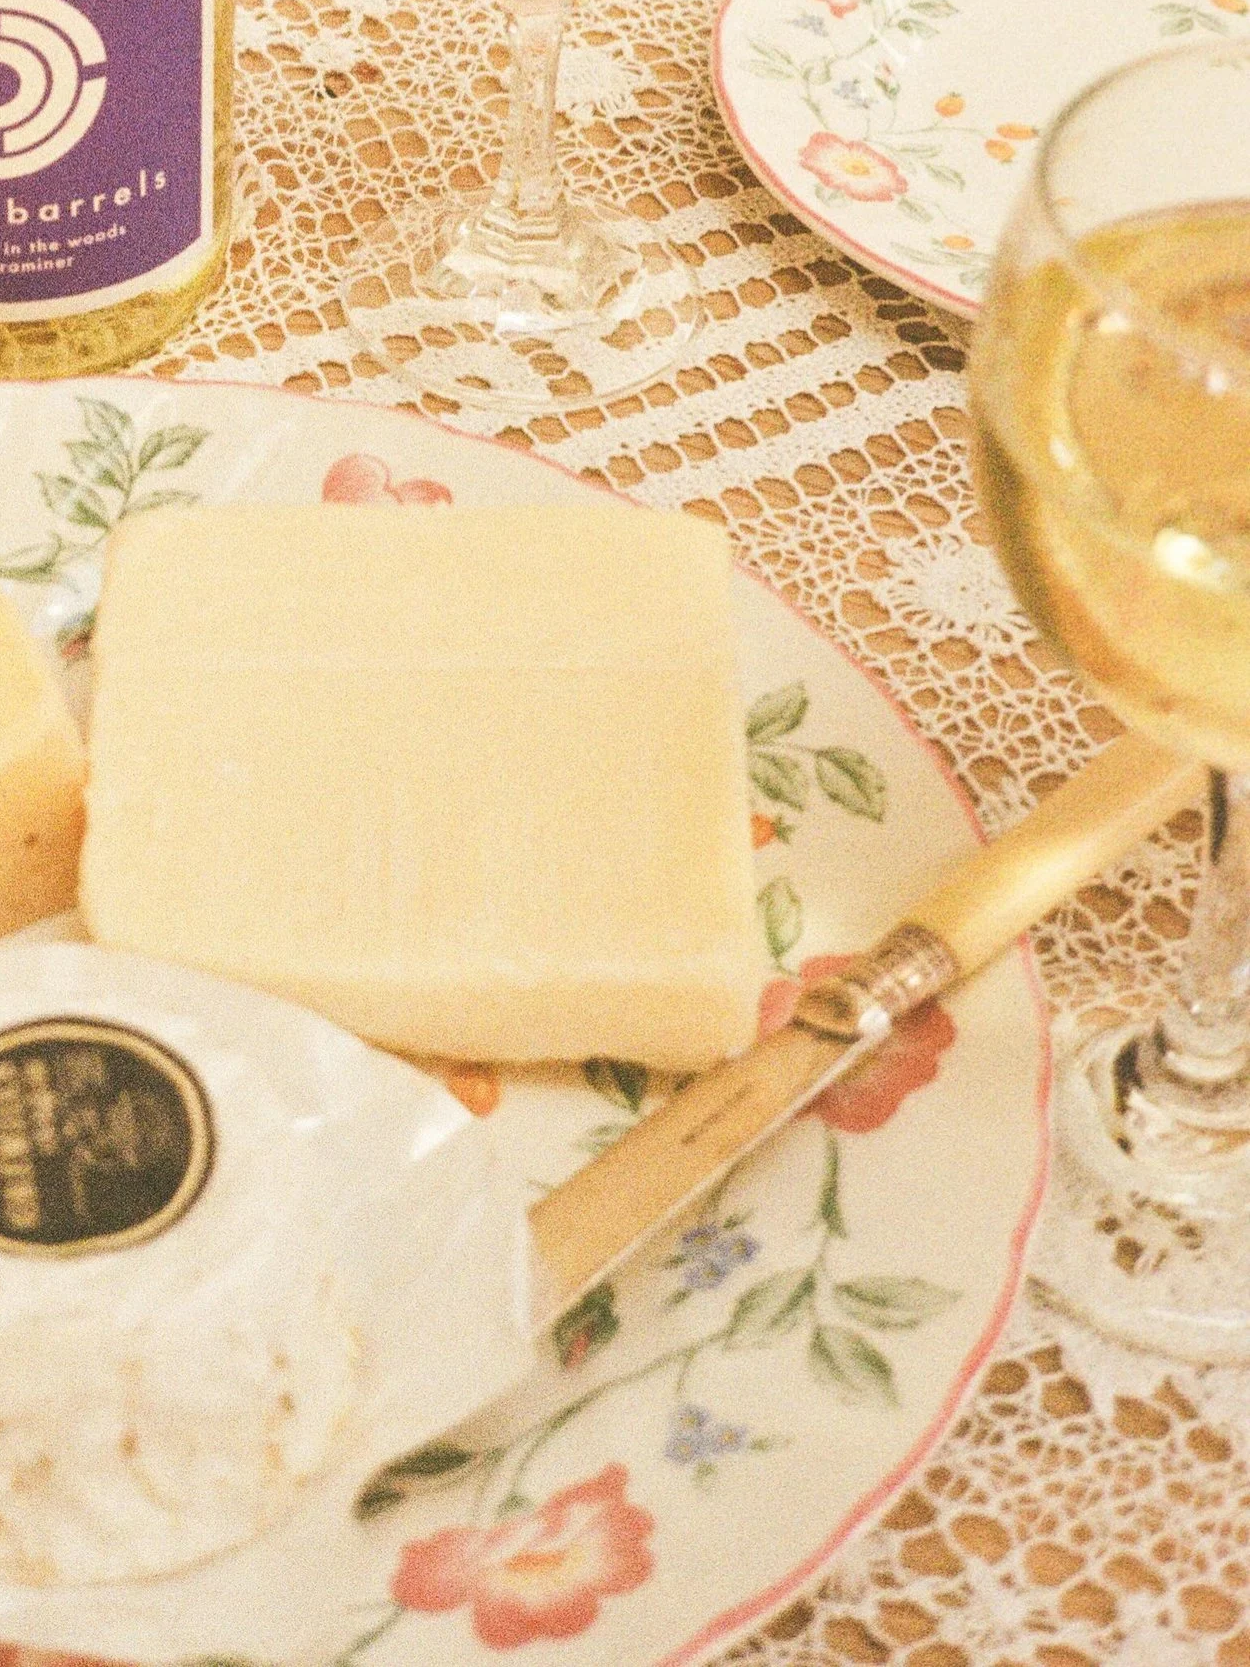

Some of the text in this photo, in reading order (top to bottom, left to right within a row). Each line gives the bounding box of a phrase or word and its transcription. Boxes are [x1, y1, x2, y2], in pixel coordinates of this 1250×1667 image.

[7, 169, 167, 225] barrels
[4, 237, 22, 255] in
[30, 238, 60, 254] the
[68, 224, 127, 248] woods
